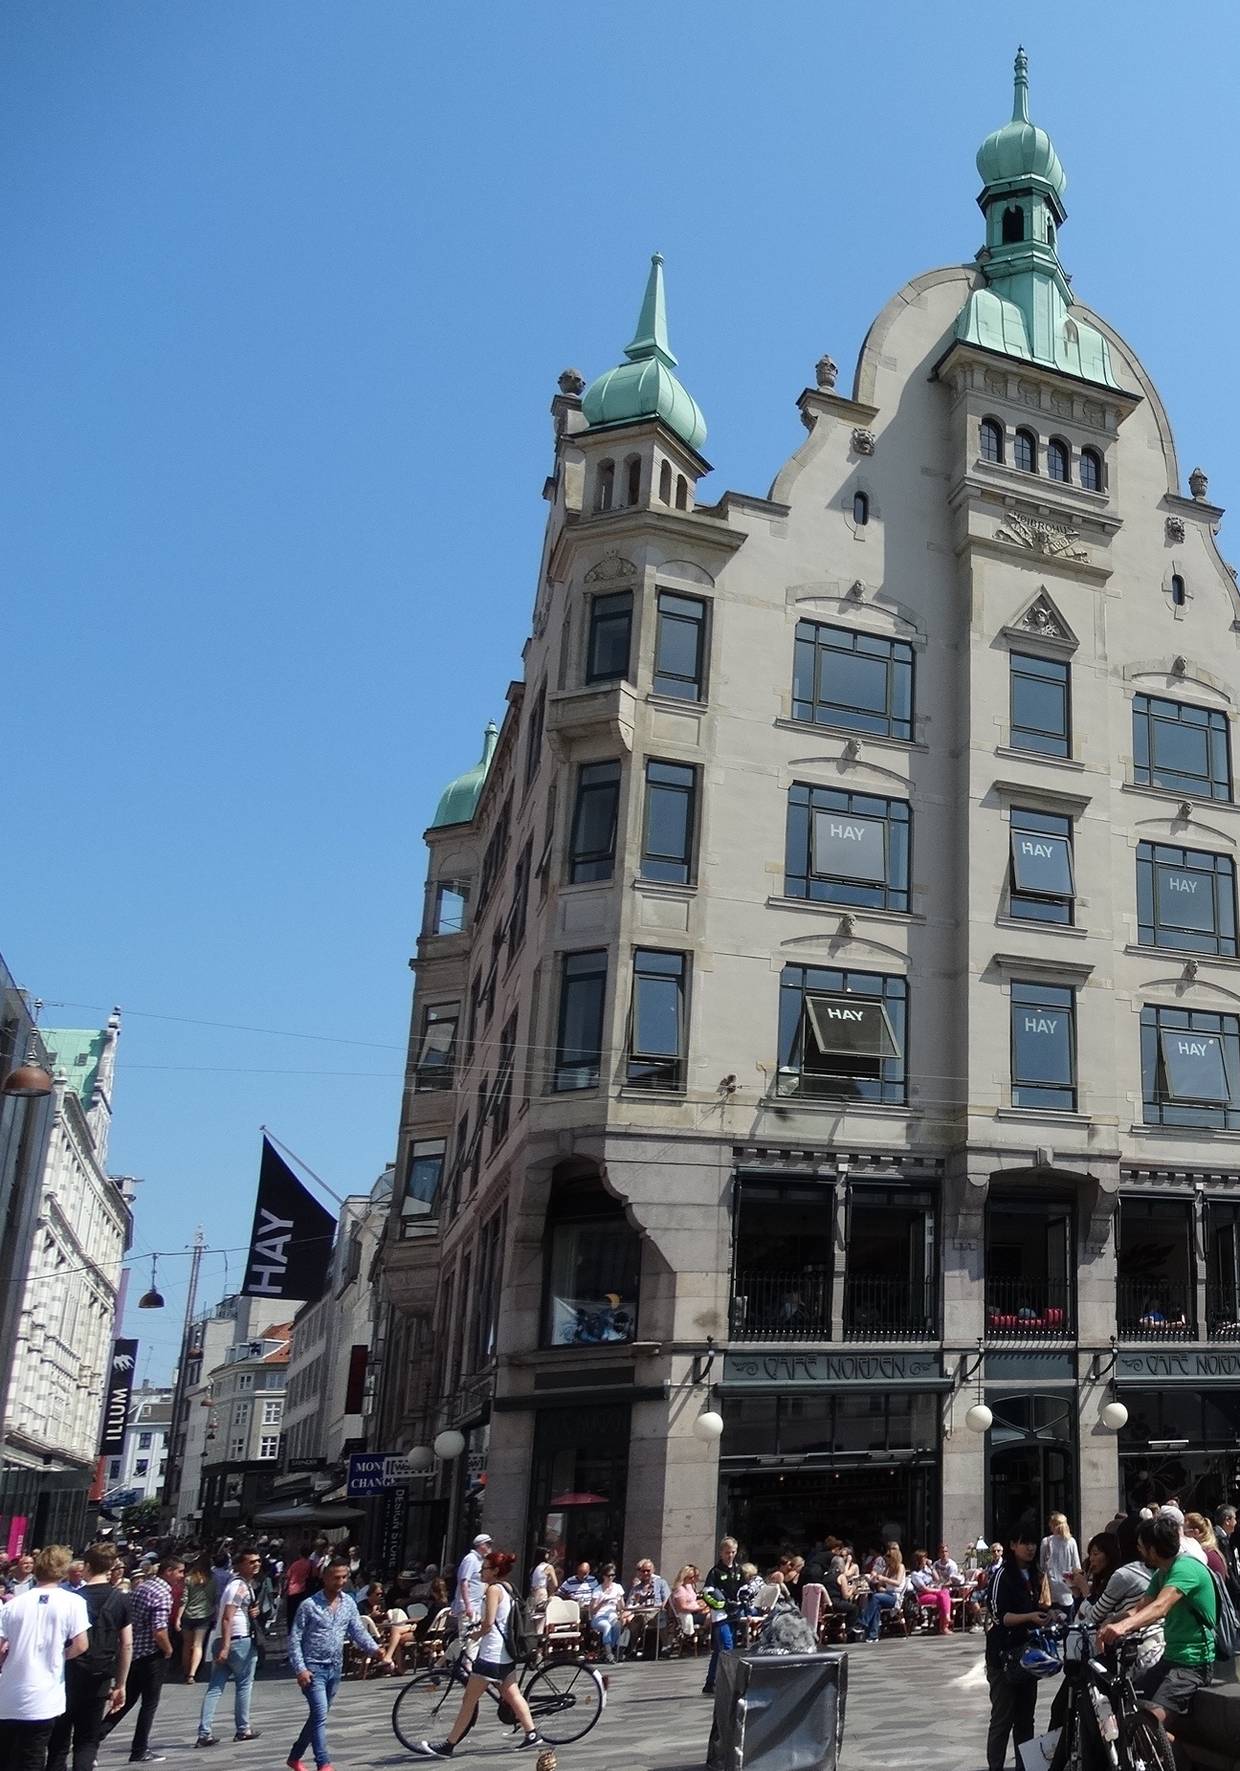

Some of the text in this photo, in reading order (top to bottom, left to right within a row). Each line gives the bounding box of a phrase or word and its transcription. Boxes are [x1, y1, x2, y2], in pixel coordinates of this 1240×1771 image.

[831, 824, 864, 841] HAY
[1022, 842, 1053, 858] HAY
[1170, 877, 1198, 893] HAY
[828, 1008, 864, 1021] HAY
[1025, 1018, 1057, 1034] HAY
[1178, 1042, 1207, 1056] HAY
[247, 1208, 294, 1294] HAY
[826, 1357, 905, 1380] NORDEN
[105, 1388, 128, 1441] ILLUM
